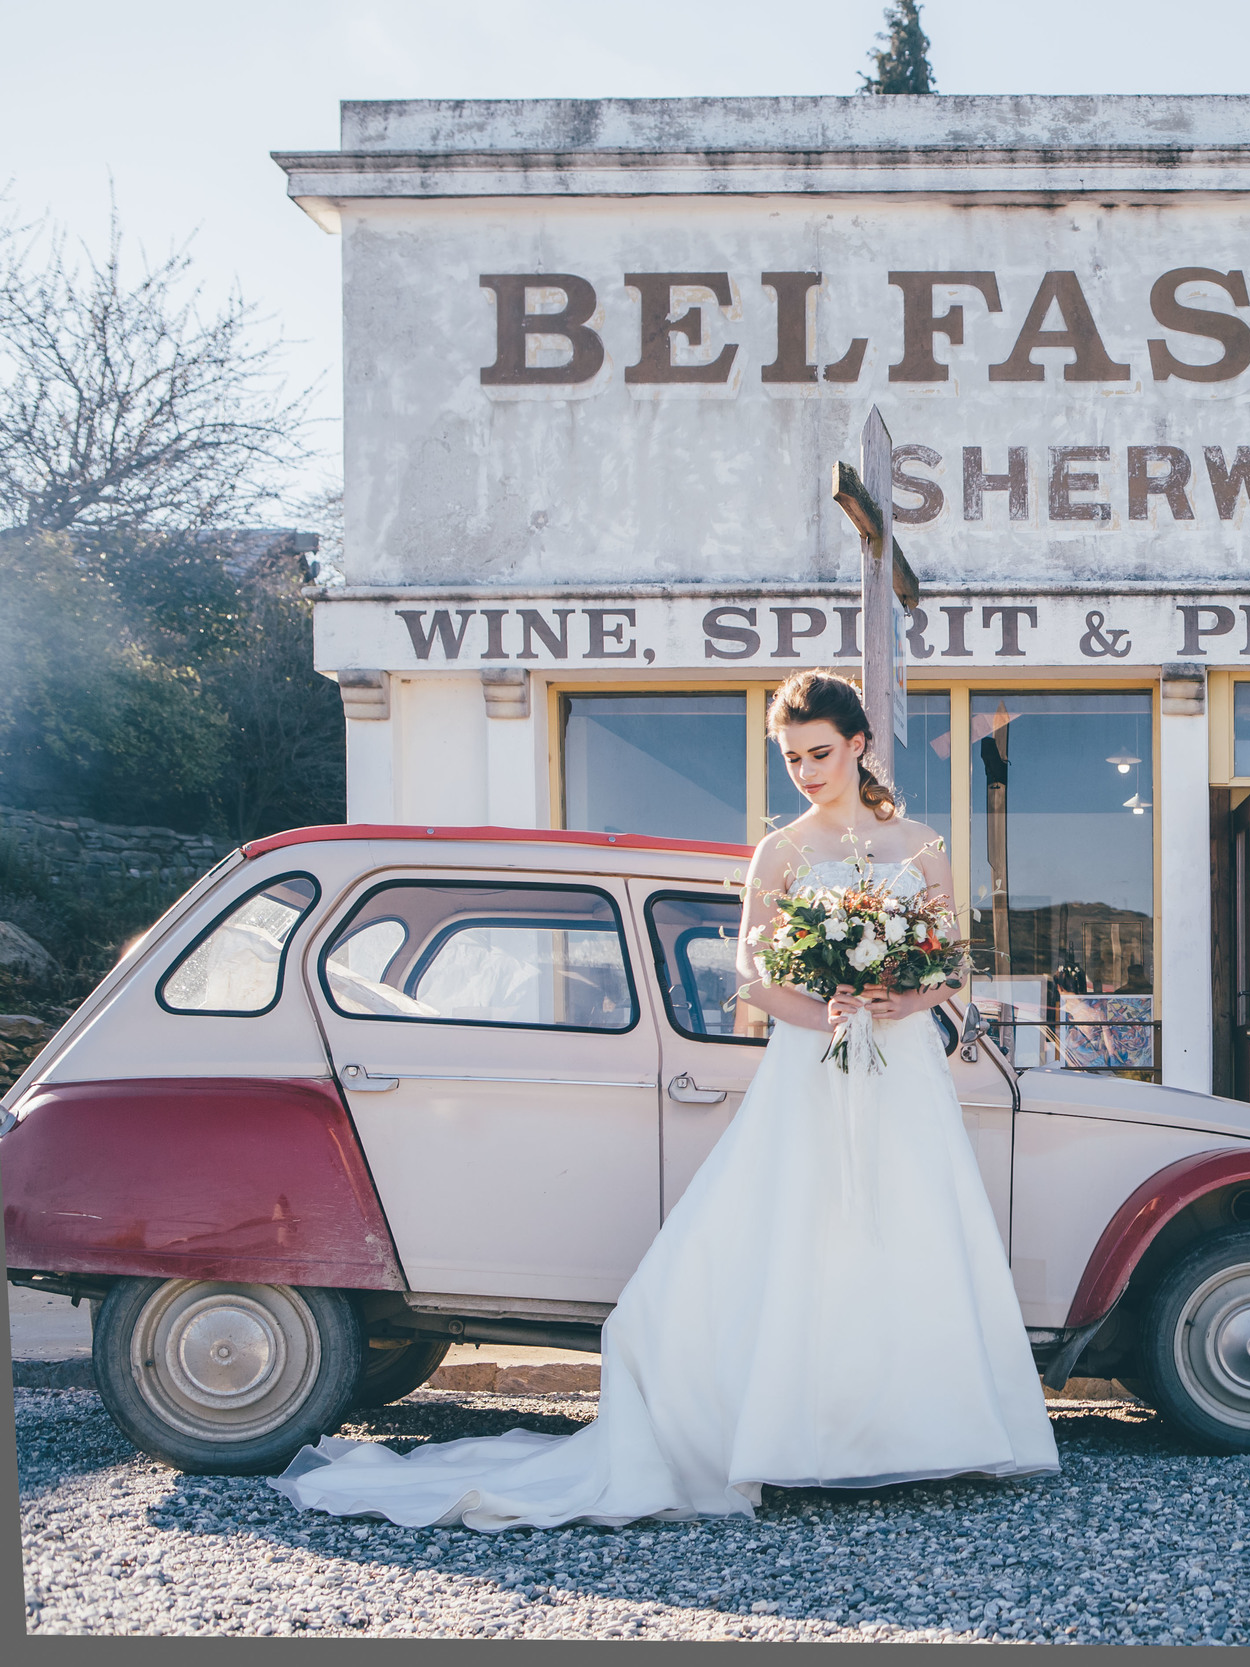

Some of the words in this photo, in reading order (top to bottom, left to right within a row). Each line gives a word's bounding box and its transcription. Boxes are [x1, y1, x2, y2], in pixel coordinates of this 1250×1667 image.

[395, 608, 655, 666] WINE,
[702, 606, 1038, 660] SPIRIT
[1079, 611, 1132, 658] &
